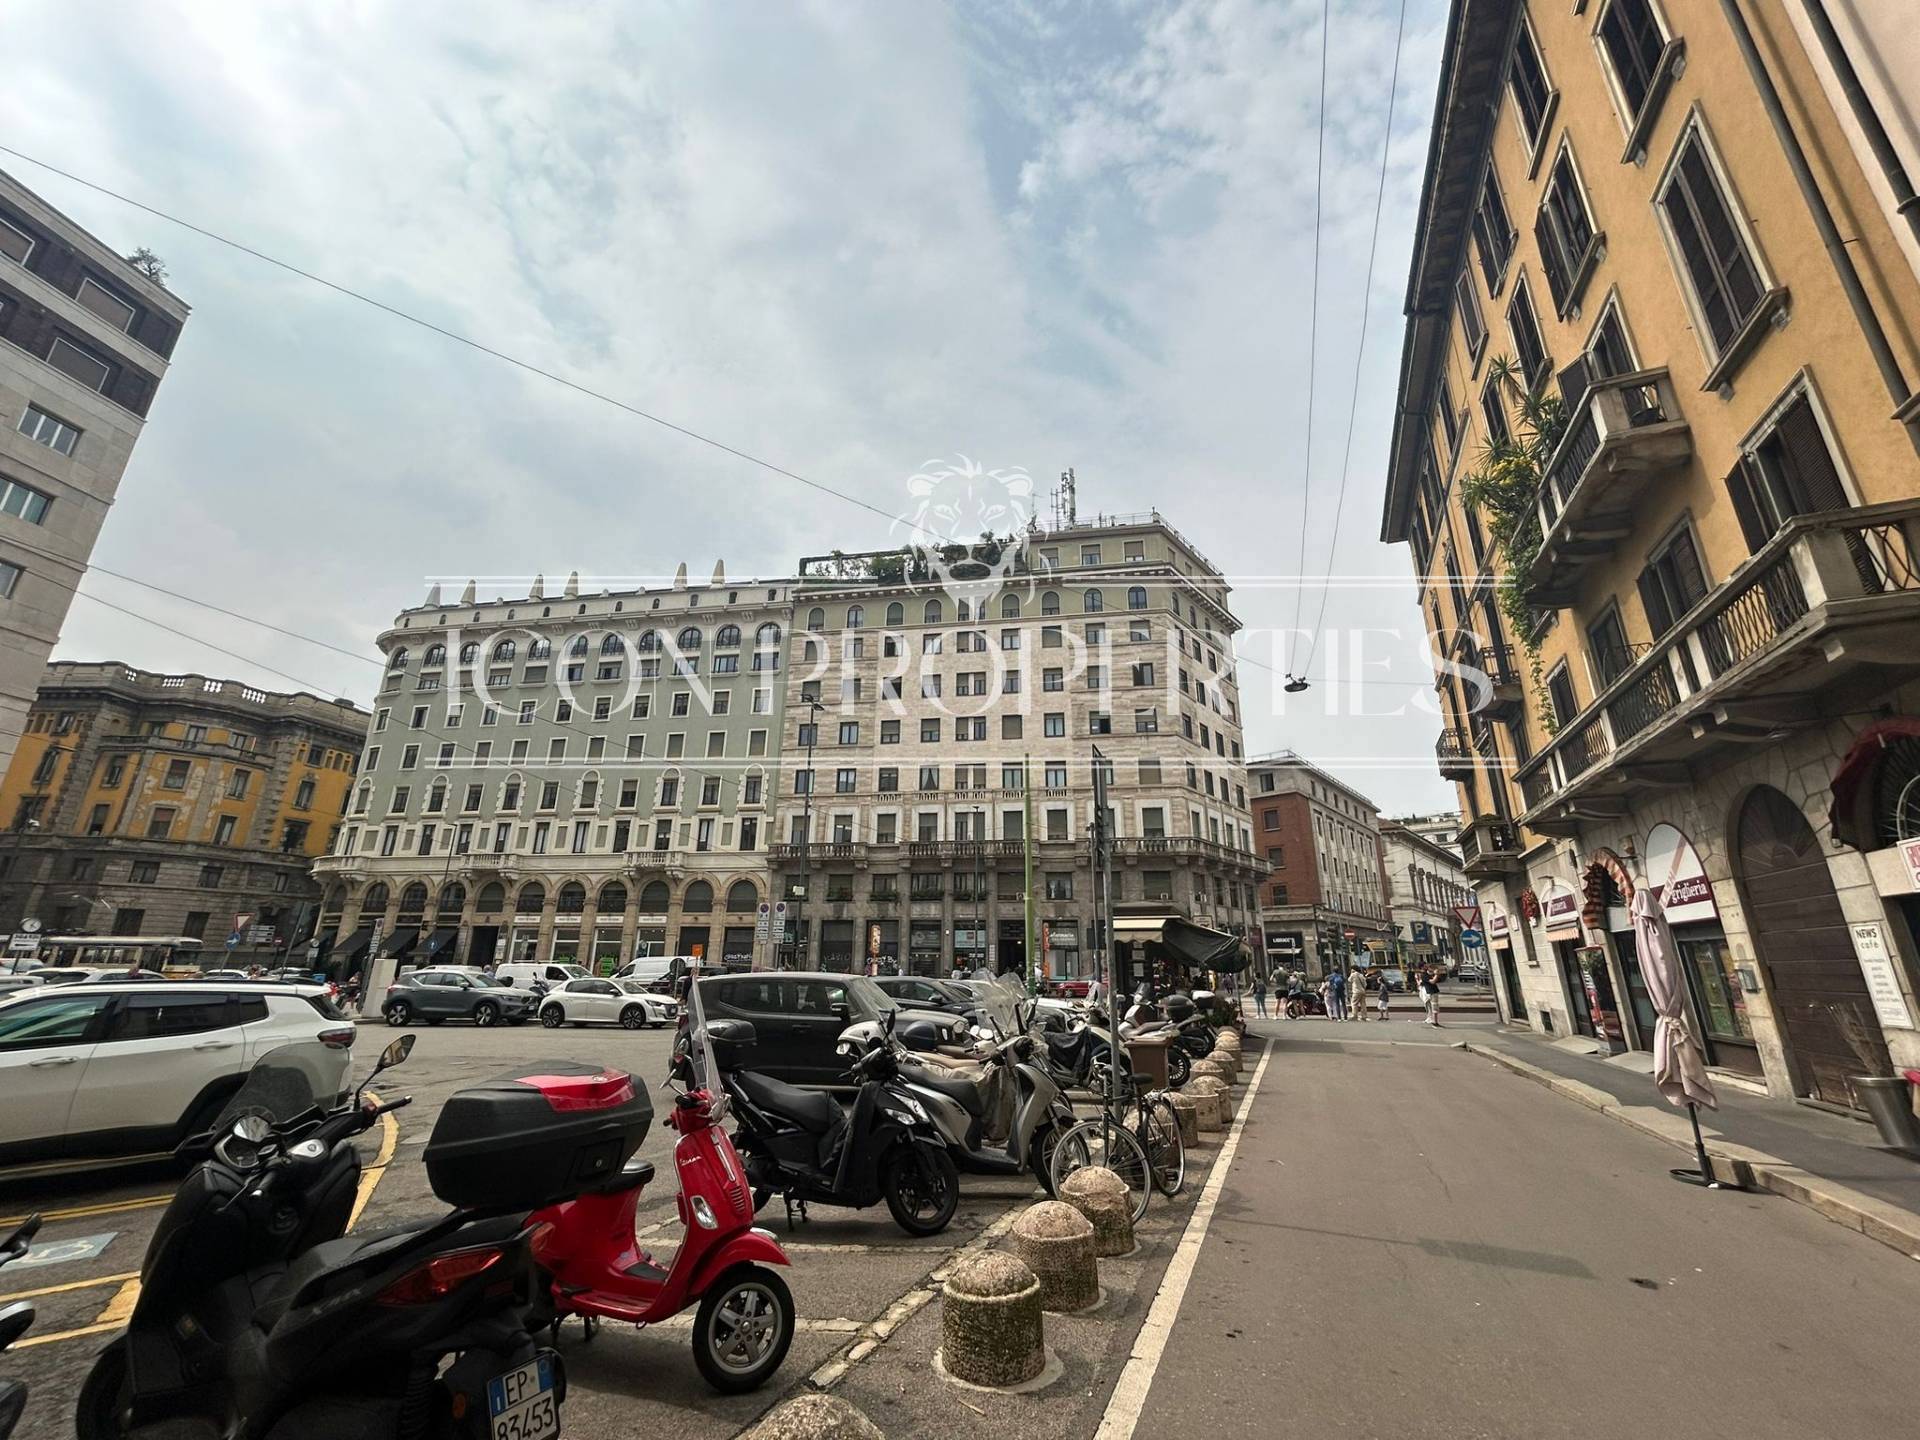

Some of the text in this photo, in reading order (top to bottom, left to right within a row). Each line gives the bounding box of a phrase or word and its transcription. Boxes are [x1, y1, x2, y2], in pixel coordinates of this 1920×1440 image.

[1672, 880, 1708, 904] griglieria
[1415, 923, 1424, 935] P
[1855, 928, 1878, 939] NEWS
[505, 1370, 528, 1406] EP
[496, 1396, 554, 1440] 83453
